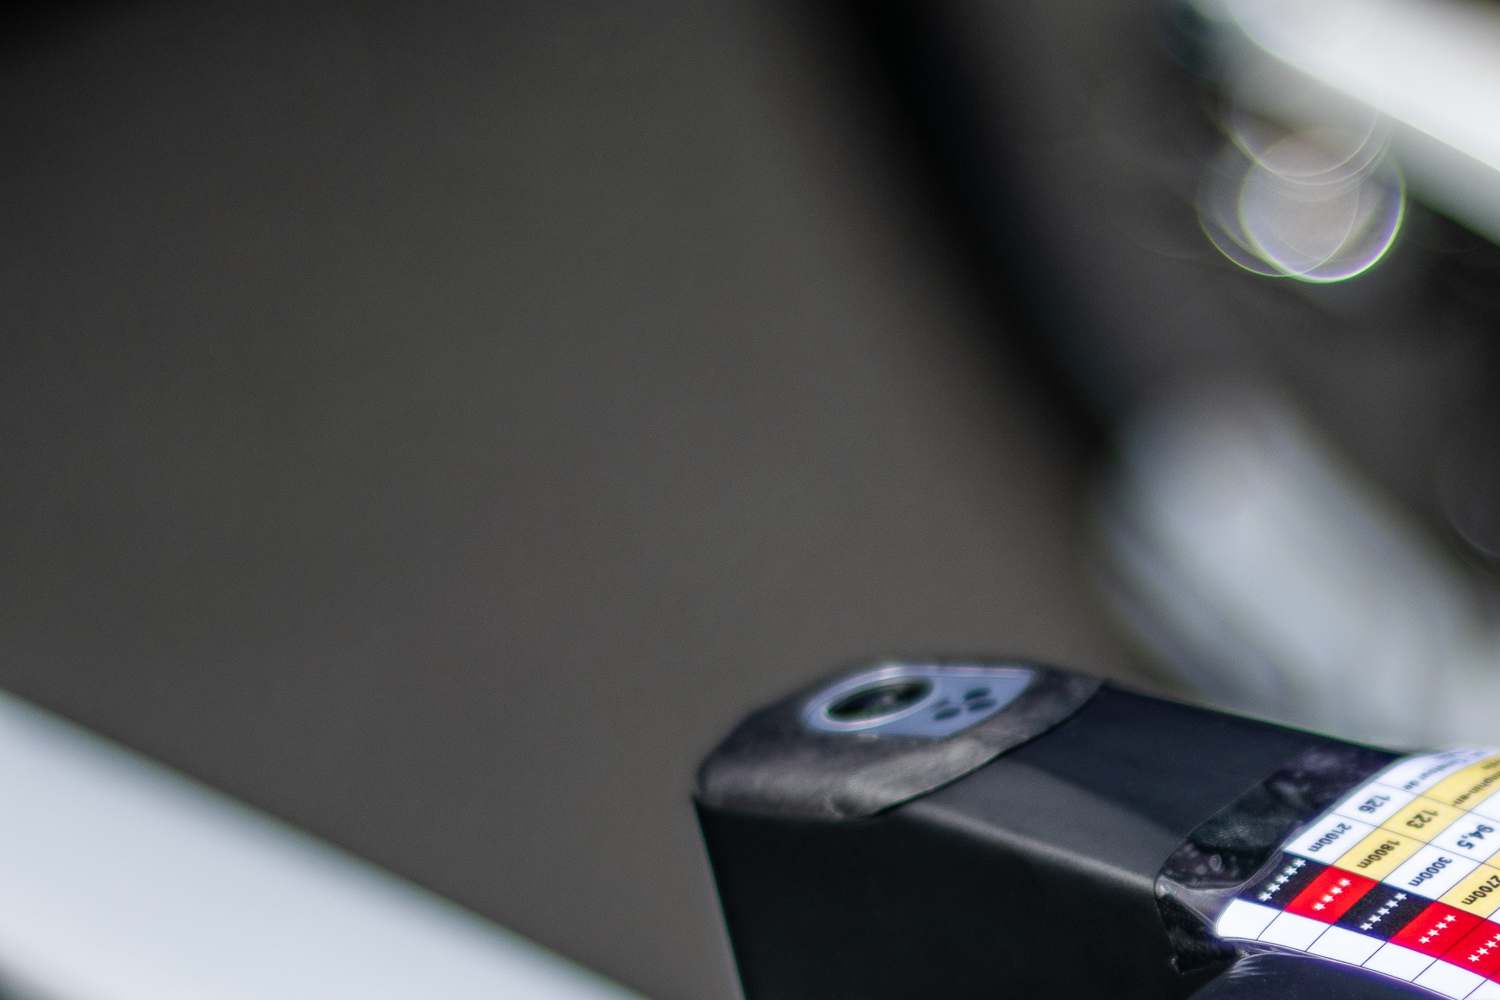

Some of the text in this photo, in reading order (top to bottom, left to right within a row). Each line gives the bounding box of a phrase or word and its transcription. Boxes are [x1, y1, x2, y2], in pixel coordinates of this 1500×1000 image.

[1358, 794, 1391, 814] 126
[1406, 809, 1440, 829] 123
[1307, 822, 1352, 852] 2100m
[1456, 824, 1495, 850] 94,5
[1356, 840, 1401, 869] 1800m
[1408, 856, 1453, 887] 3000m
